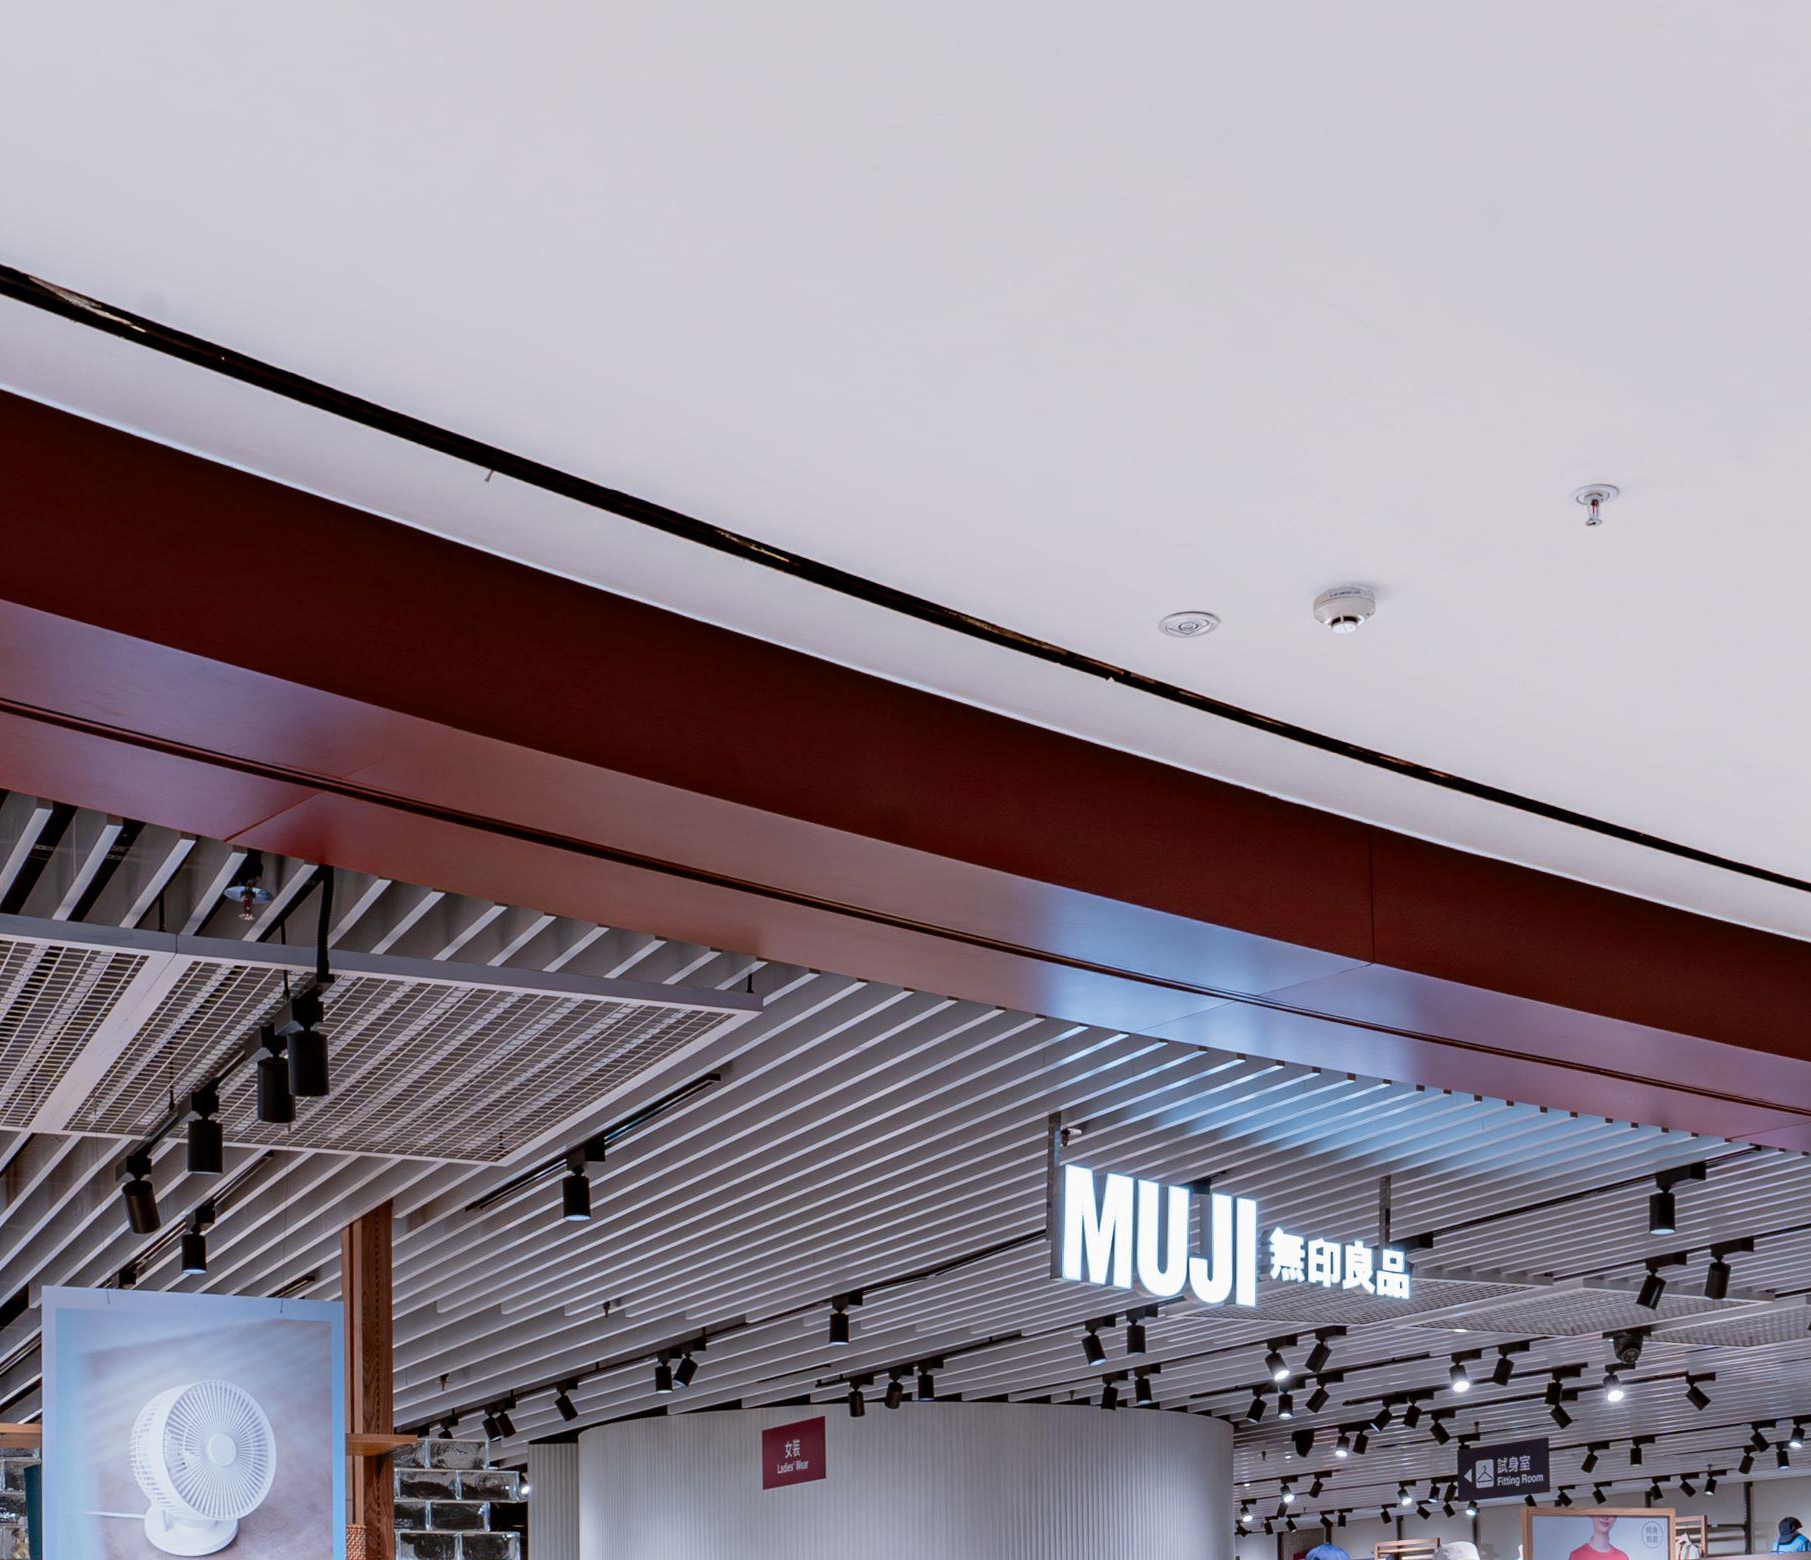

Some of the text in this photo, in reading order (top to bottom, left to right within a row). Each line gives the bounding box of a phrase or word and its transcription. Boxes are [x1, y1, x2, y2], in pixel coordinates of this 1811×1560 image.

[1061, 1164, 1257, 1307] MUJI
[1268, 1226, 1412, 1300] 無印良品
[796, 1460, 809, 1471] Wear
[1497, 1455, 1531, 1474] 試身室
[1497, 1474, 1544, 1487] Fitting Room
